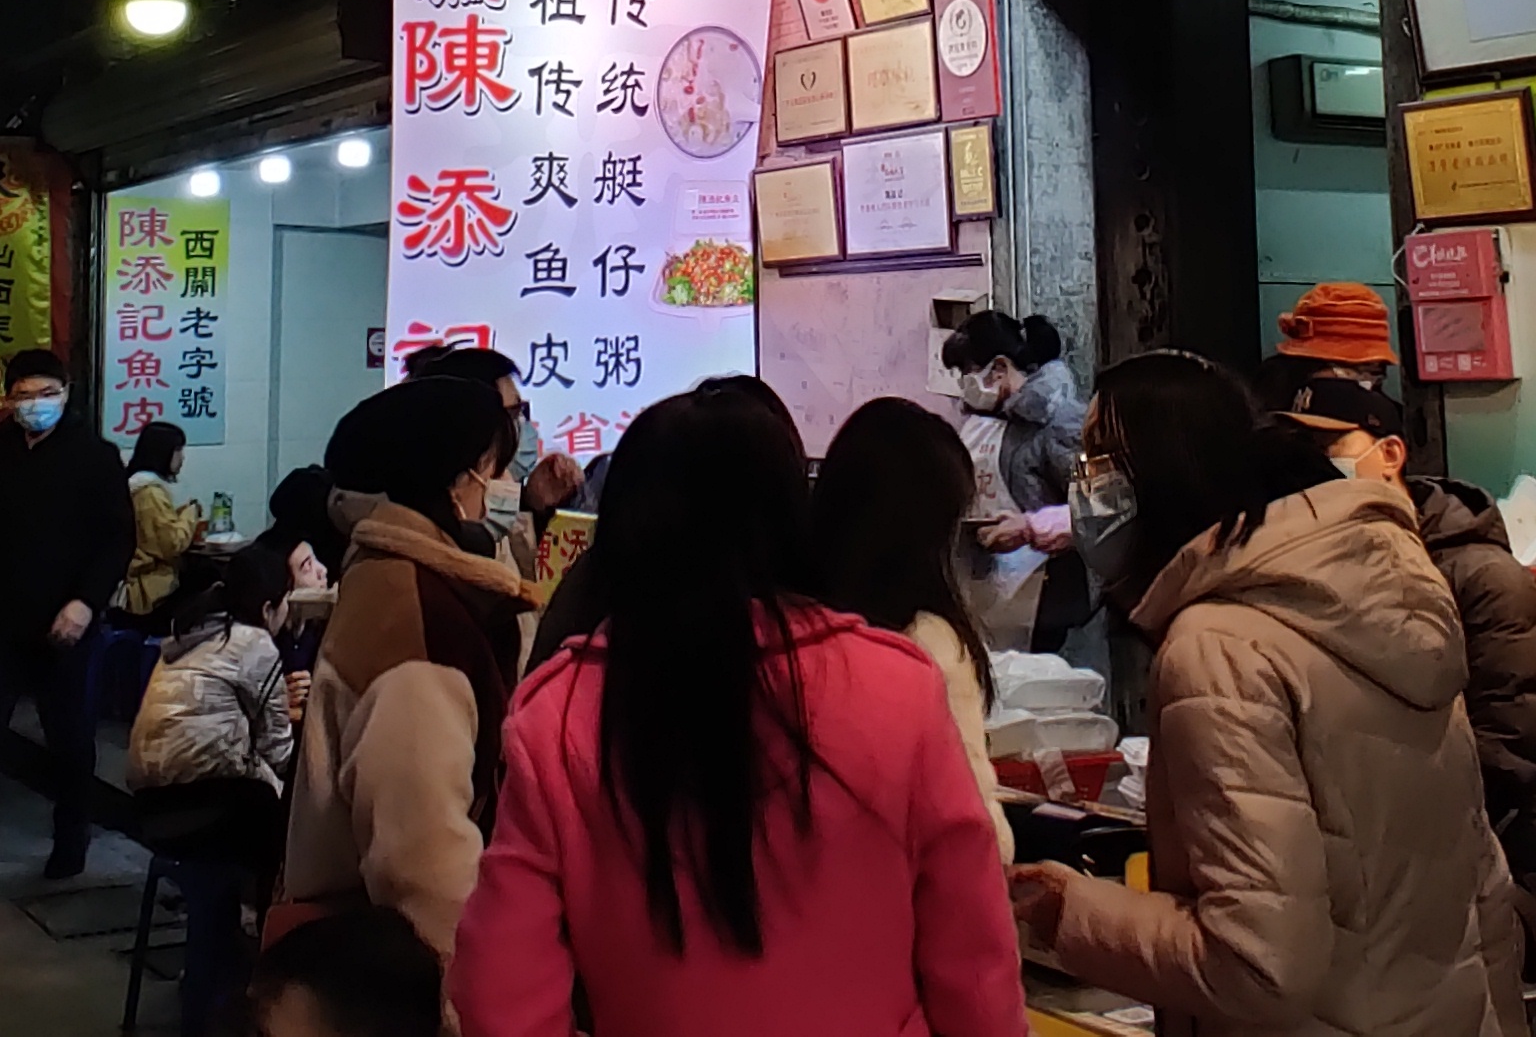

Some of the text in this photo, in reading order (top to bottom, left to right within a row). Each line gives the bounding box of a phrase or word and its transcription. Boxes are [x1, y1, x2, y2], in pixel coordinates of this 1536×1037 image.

[112, 206, 175, 437] 陳添記魚皮
[178, 228, 220, 420] 西關老字號
